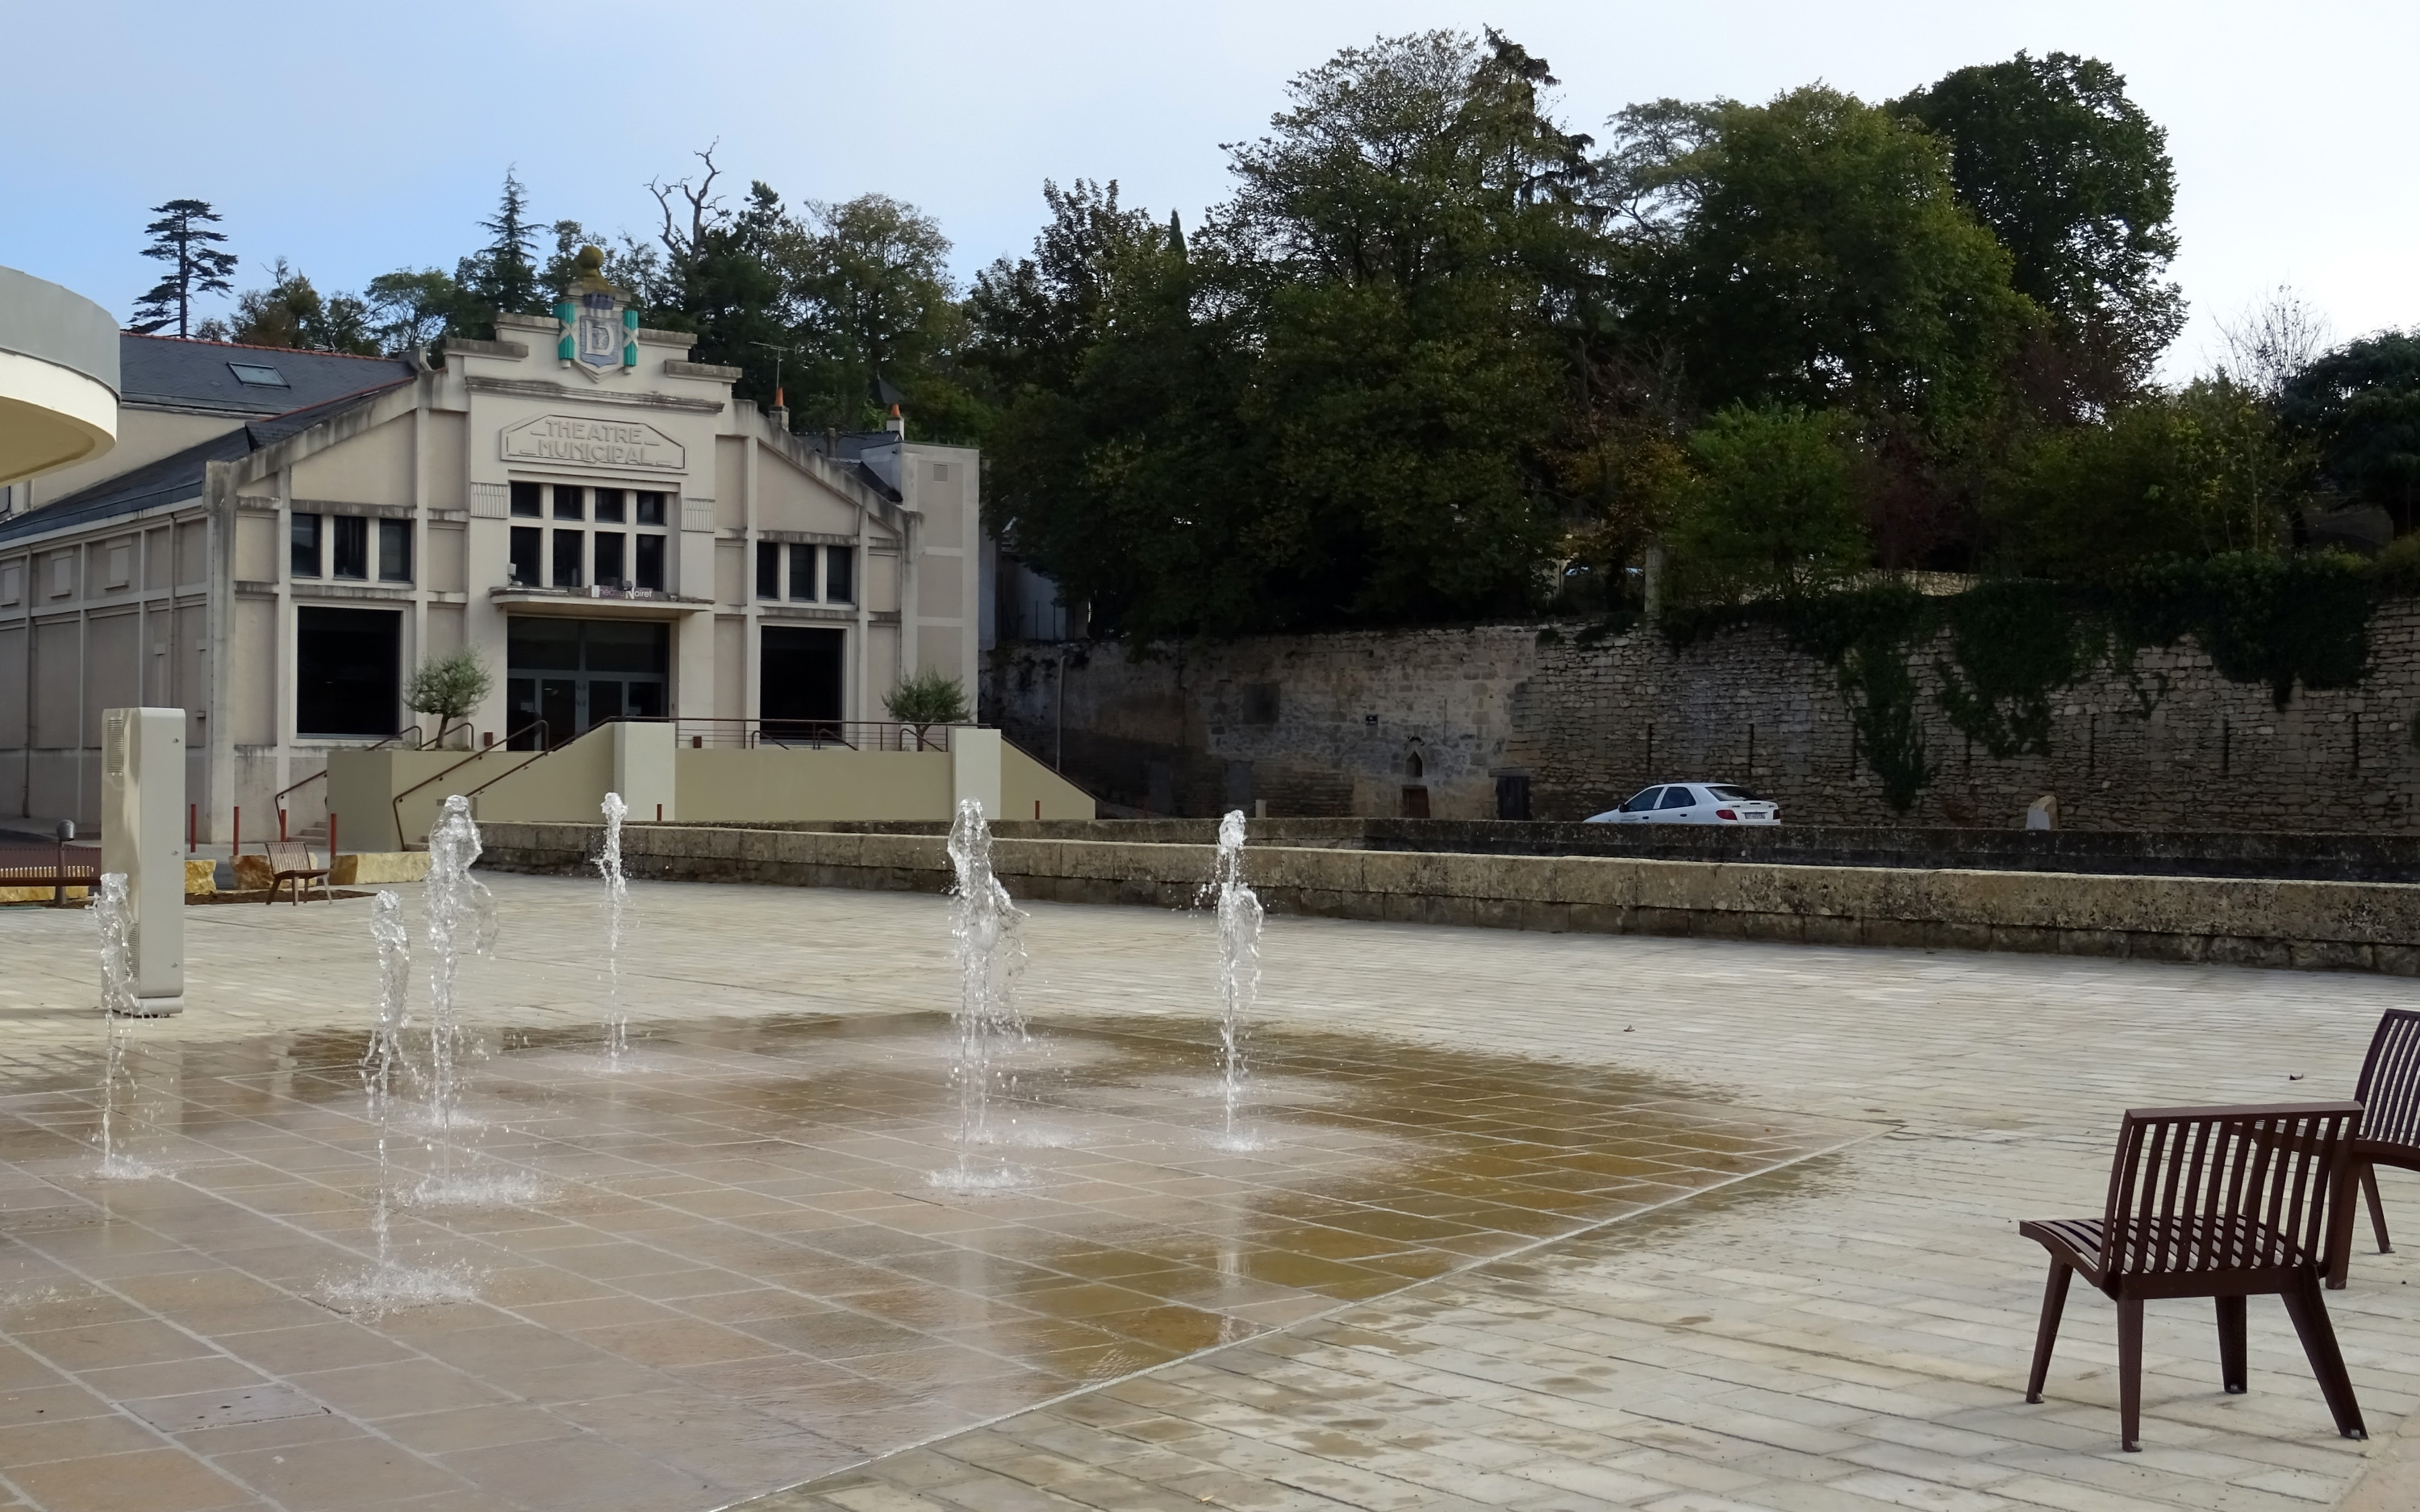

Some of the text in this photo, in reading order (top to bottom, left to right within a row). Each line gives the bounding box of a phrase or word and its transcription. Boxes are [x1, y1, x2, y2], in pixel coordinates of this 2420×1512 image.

[545, 419, 642, 444] THEATRE
[538, 439, 653, 465] MUNICIPAL
[591, 585, 653, 600] héâte Noiret
